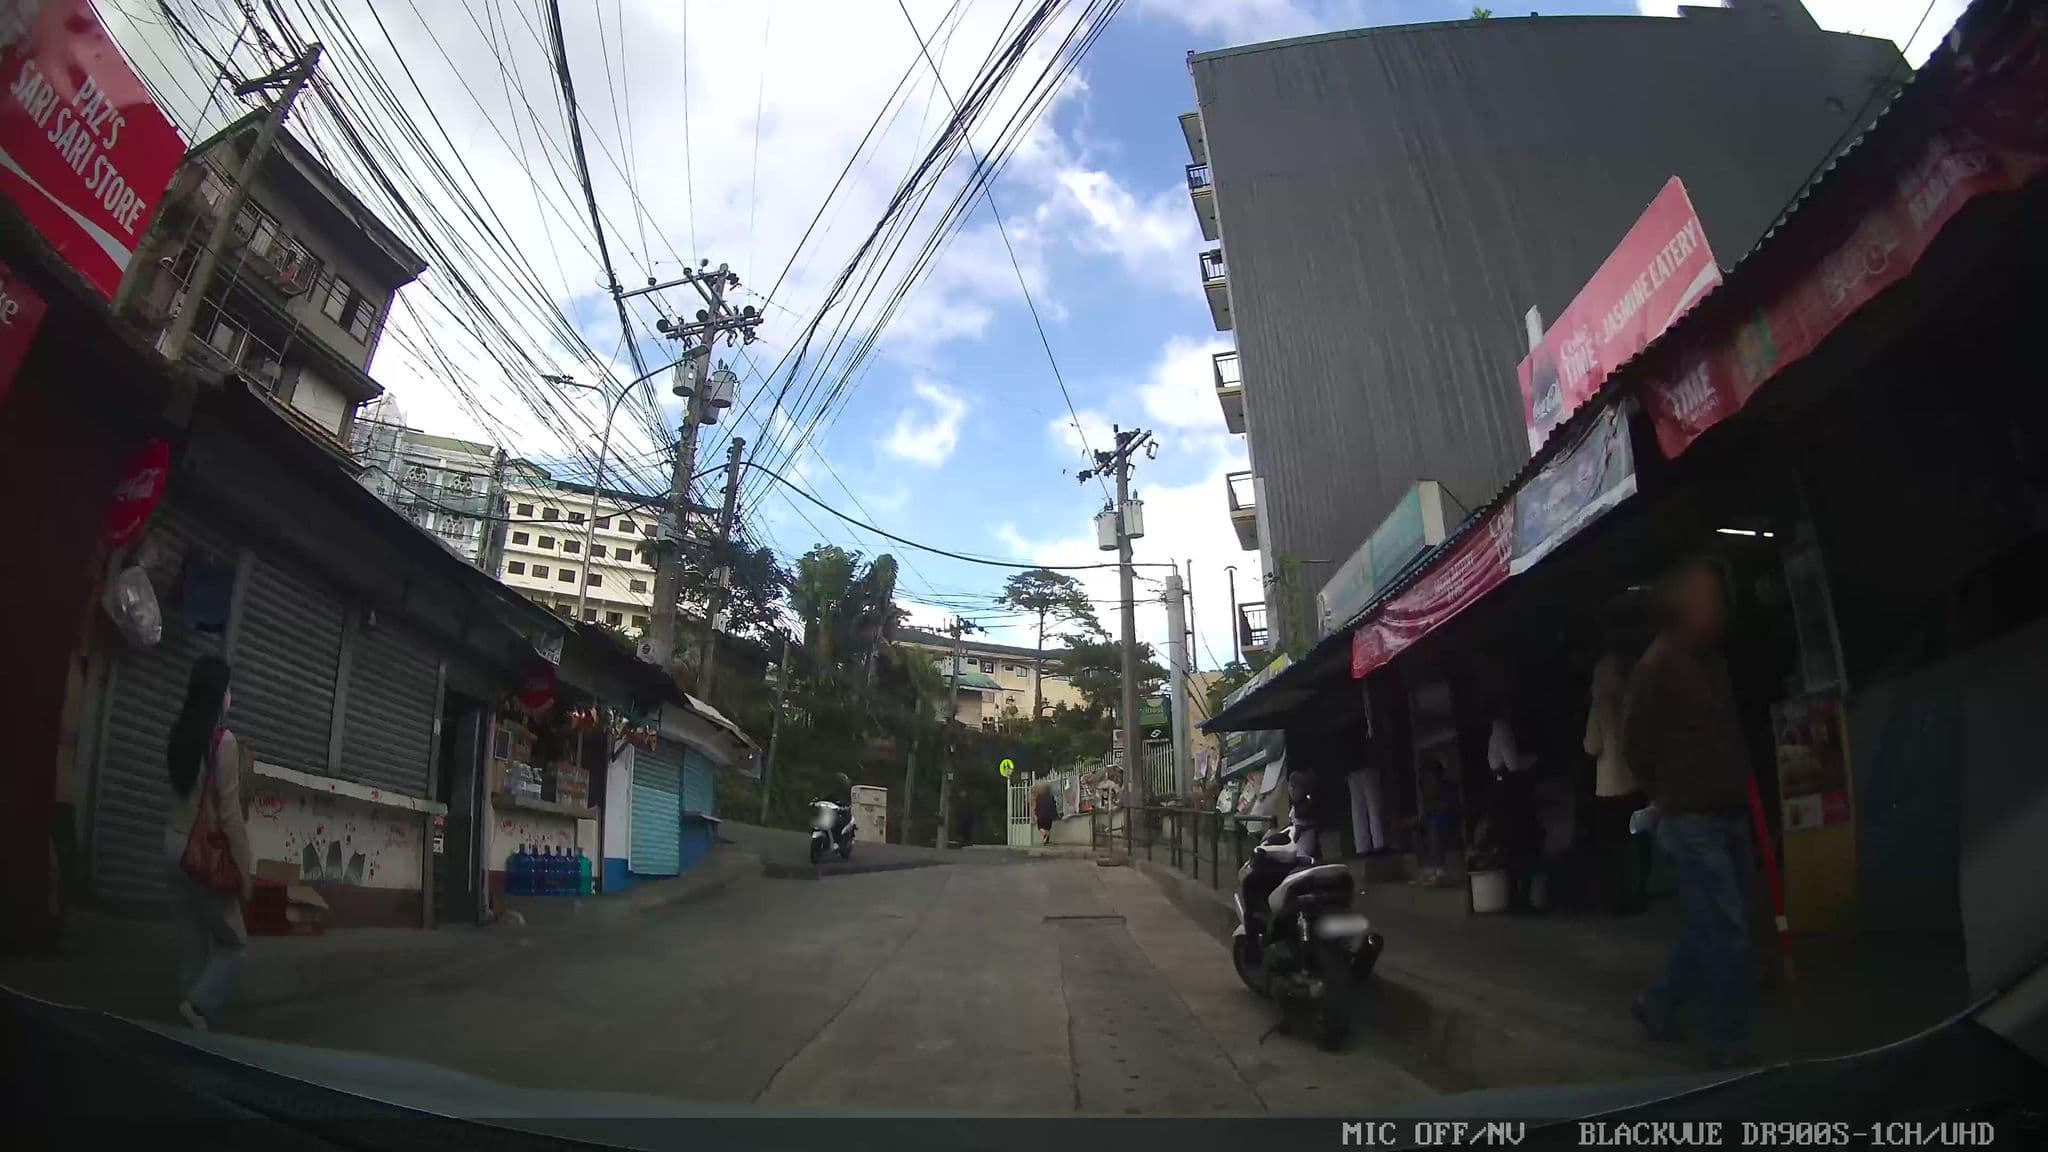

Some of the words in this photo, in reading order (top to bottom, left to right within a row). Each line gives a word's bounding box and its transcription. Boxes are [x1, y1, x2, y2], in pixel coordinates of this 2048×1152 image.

[10, 59, 60, 129] SARI
[48, 107, 98, 176] SARI
[85, 154, 147, 236] STORE
[71, 74, 126, 150] PAZ'S
[1603, 270, 1653, 345] JASMINE
[1650, 217, 1699, 292] EATERY
